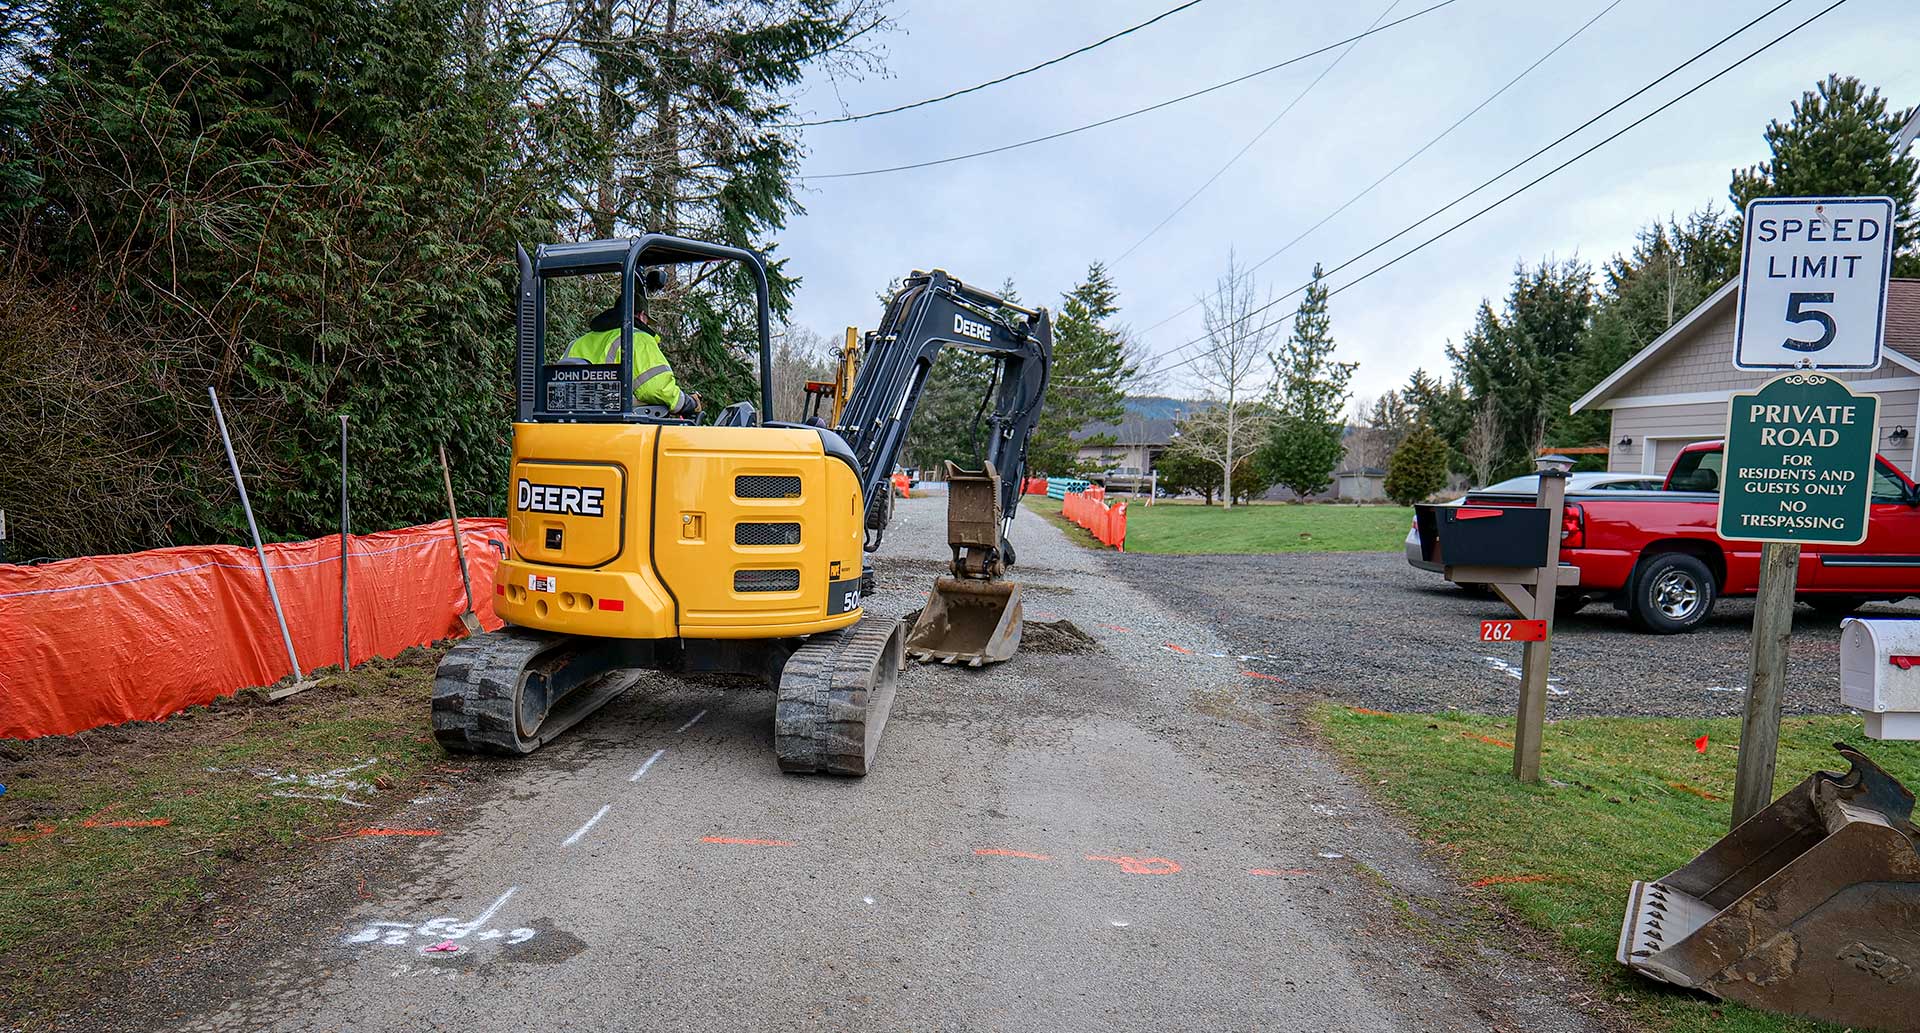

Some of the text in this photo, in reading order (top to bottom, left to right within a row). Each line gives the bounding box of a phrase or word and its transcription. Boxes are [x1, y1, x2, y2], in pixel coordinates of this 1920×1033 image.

[1758, 219, 1880, 242] SPEED
[1768, 255, 1862, 279] LIMIT
[953, 313, 992, 342] DEERE
[1782, 292, 1837, 352] 5
[552, 369, 618, 381] JOHN DEERE
[1750, 404, 1856, 425] PRIVATE
[1760, 427, 1840, 447] ROAD
[1782, 454, 1813, 466] FOR
[1738, 467, 1855, 482] RESIDENTS AND
[517, 480, 603, 515] DEERE
[1744, 482, 1847, 496] GUESTS ONLY
[1779, 500, 1807, 513] NO
[1740, 514, 1845, 530] TRESPASSING
[1483, 622, 1512, 640] 262
